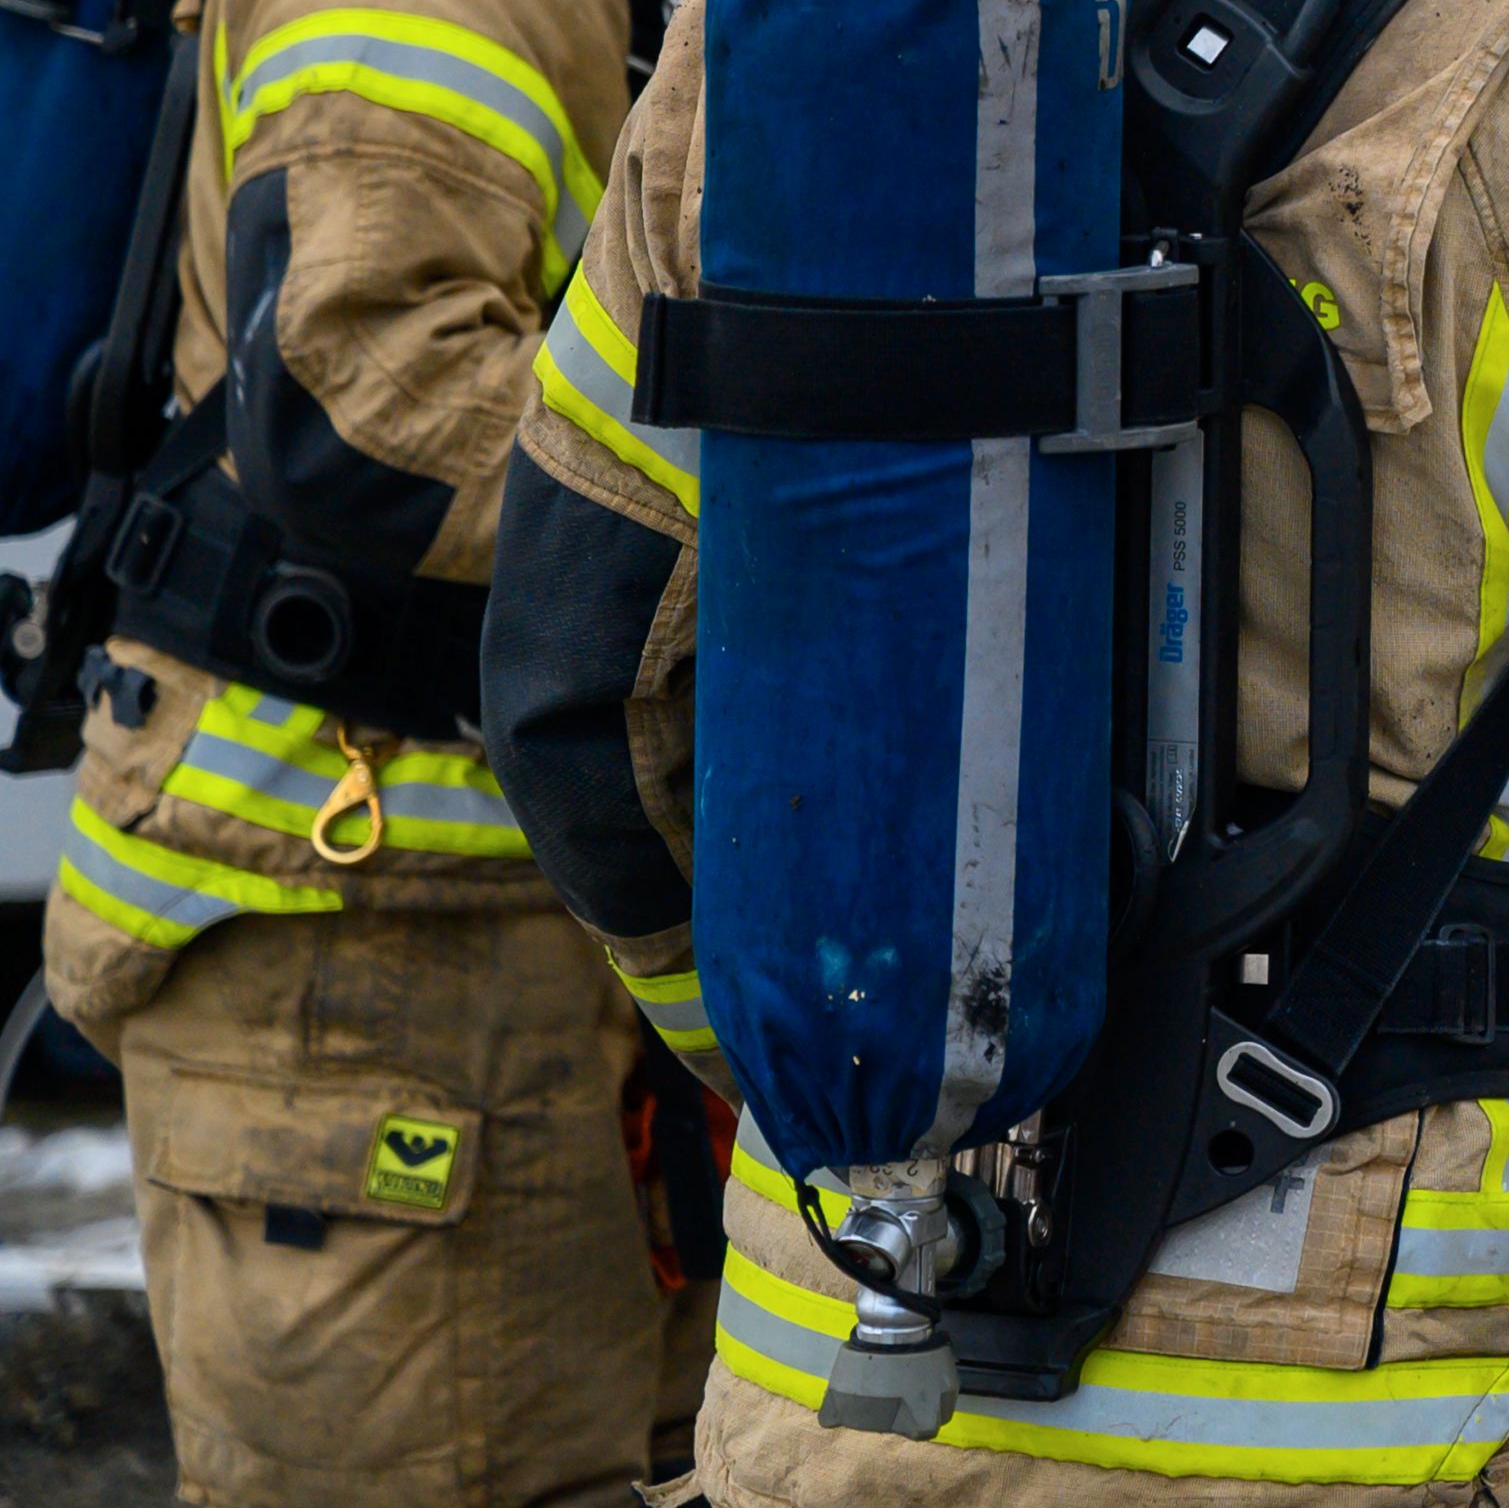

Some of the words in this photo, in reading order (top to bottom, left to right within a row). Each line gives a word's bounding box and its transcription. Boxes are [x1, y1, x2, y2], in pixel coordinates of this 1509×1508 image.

[1173, 501, 1187, 536] 5000
[1174, 540, 1186, 572] PSS
[1160, 582, 1188, 663] Dräger
